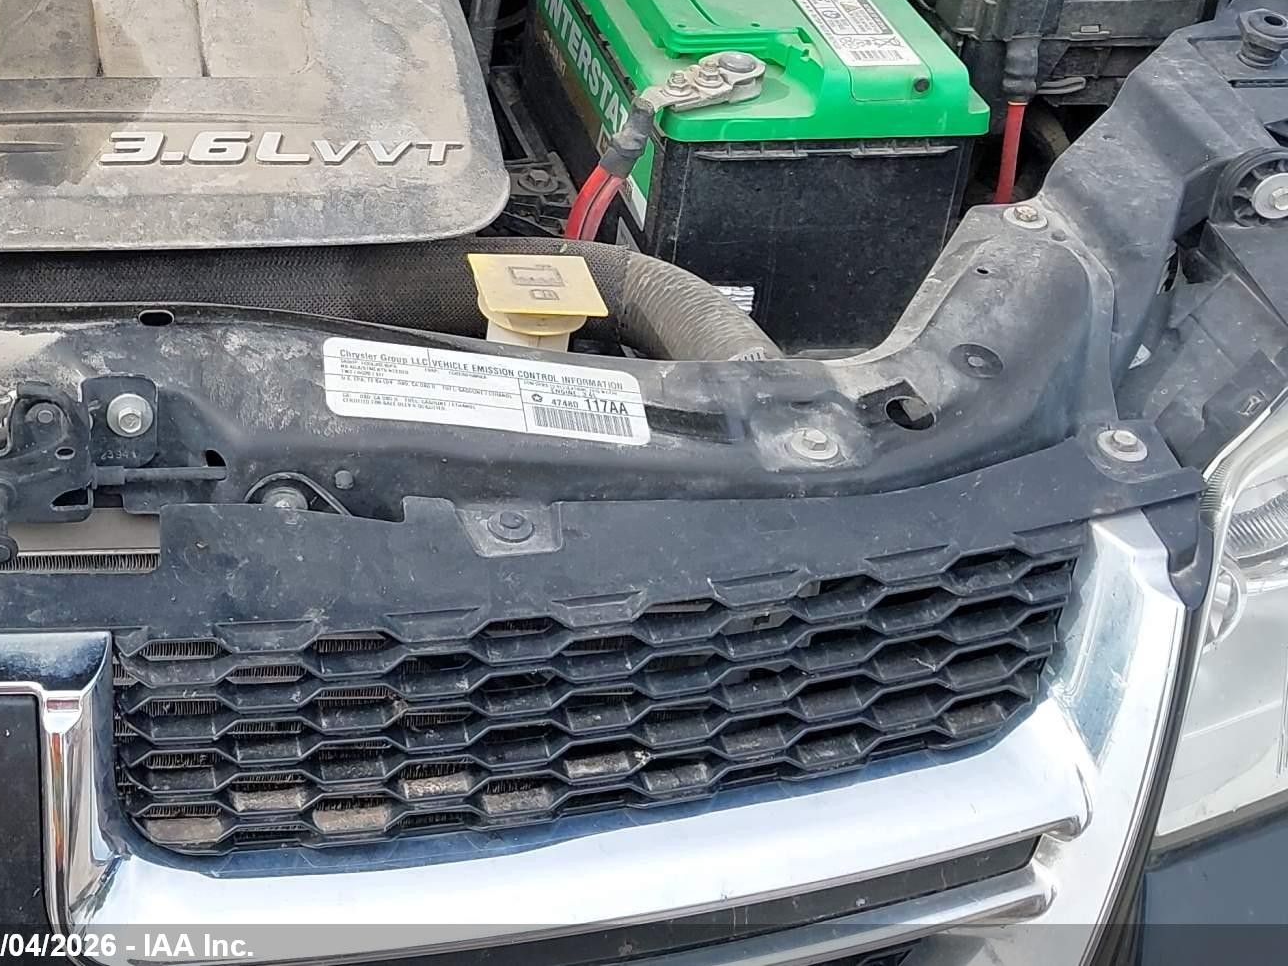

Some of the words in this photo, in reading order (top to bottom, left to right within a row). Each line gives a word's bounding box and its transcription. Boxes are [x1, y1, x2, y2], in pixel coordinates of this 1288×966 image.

[98, 131, 311, 166] 3.6L
[313, 140, 465, 166] VVT
[339, 349, 378, 362] Chrysler
[380, 354, 408, 366] Group
[411, 358, 428, 366] LLC
[431, 360, 469, 371] VEHICLE
[471, 364, 514, 377] EMISSION
[518, 370, 559, 383] CONTROL
[561, 376, 624, 390] INFORMATION
[584, 398, 629, 415] 117AA
